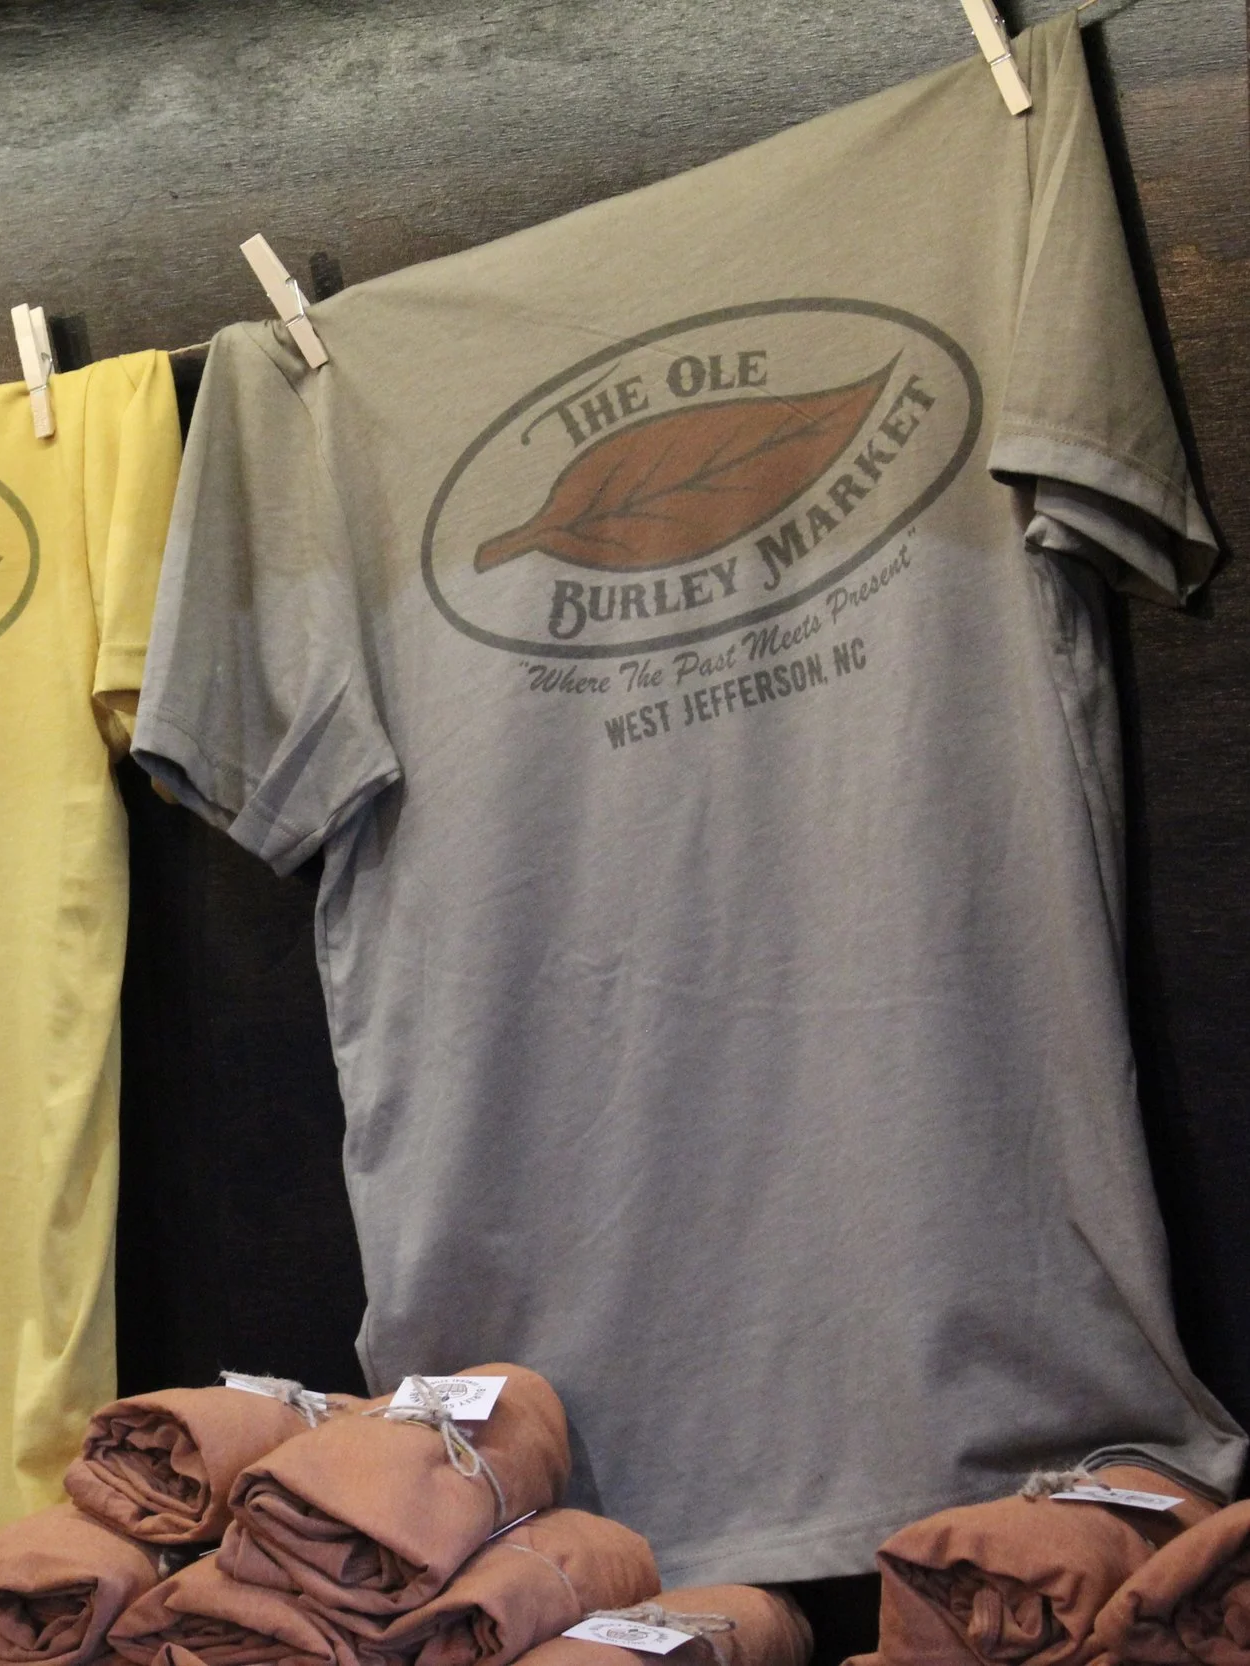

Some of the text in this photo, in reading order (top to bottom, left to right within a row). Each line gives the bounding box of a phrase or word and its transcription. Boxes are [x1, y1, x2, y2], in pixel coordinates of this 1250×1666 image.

[520, 349, 768, 449] THE OLE
[548, 374, 937, 640] BURLEY MARKET
[605, 637, 867, 750] WEST JEFFERSON, NC
[619, 659, 662, 693] The
[673, 644, 736, 686] Past
[741, 624, 822, 661] Meets
